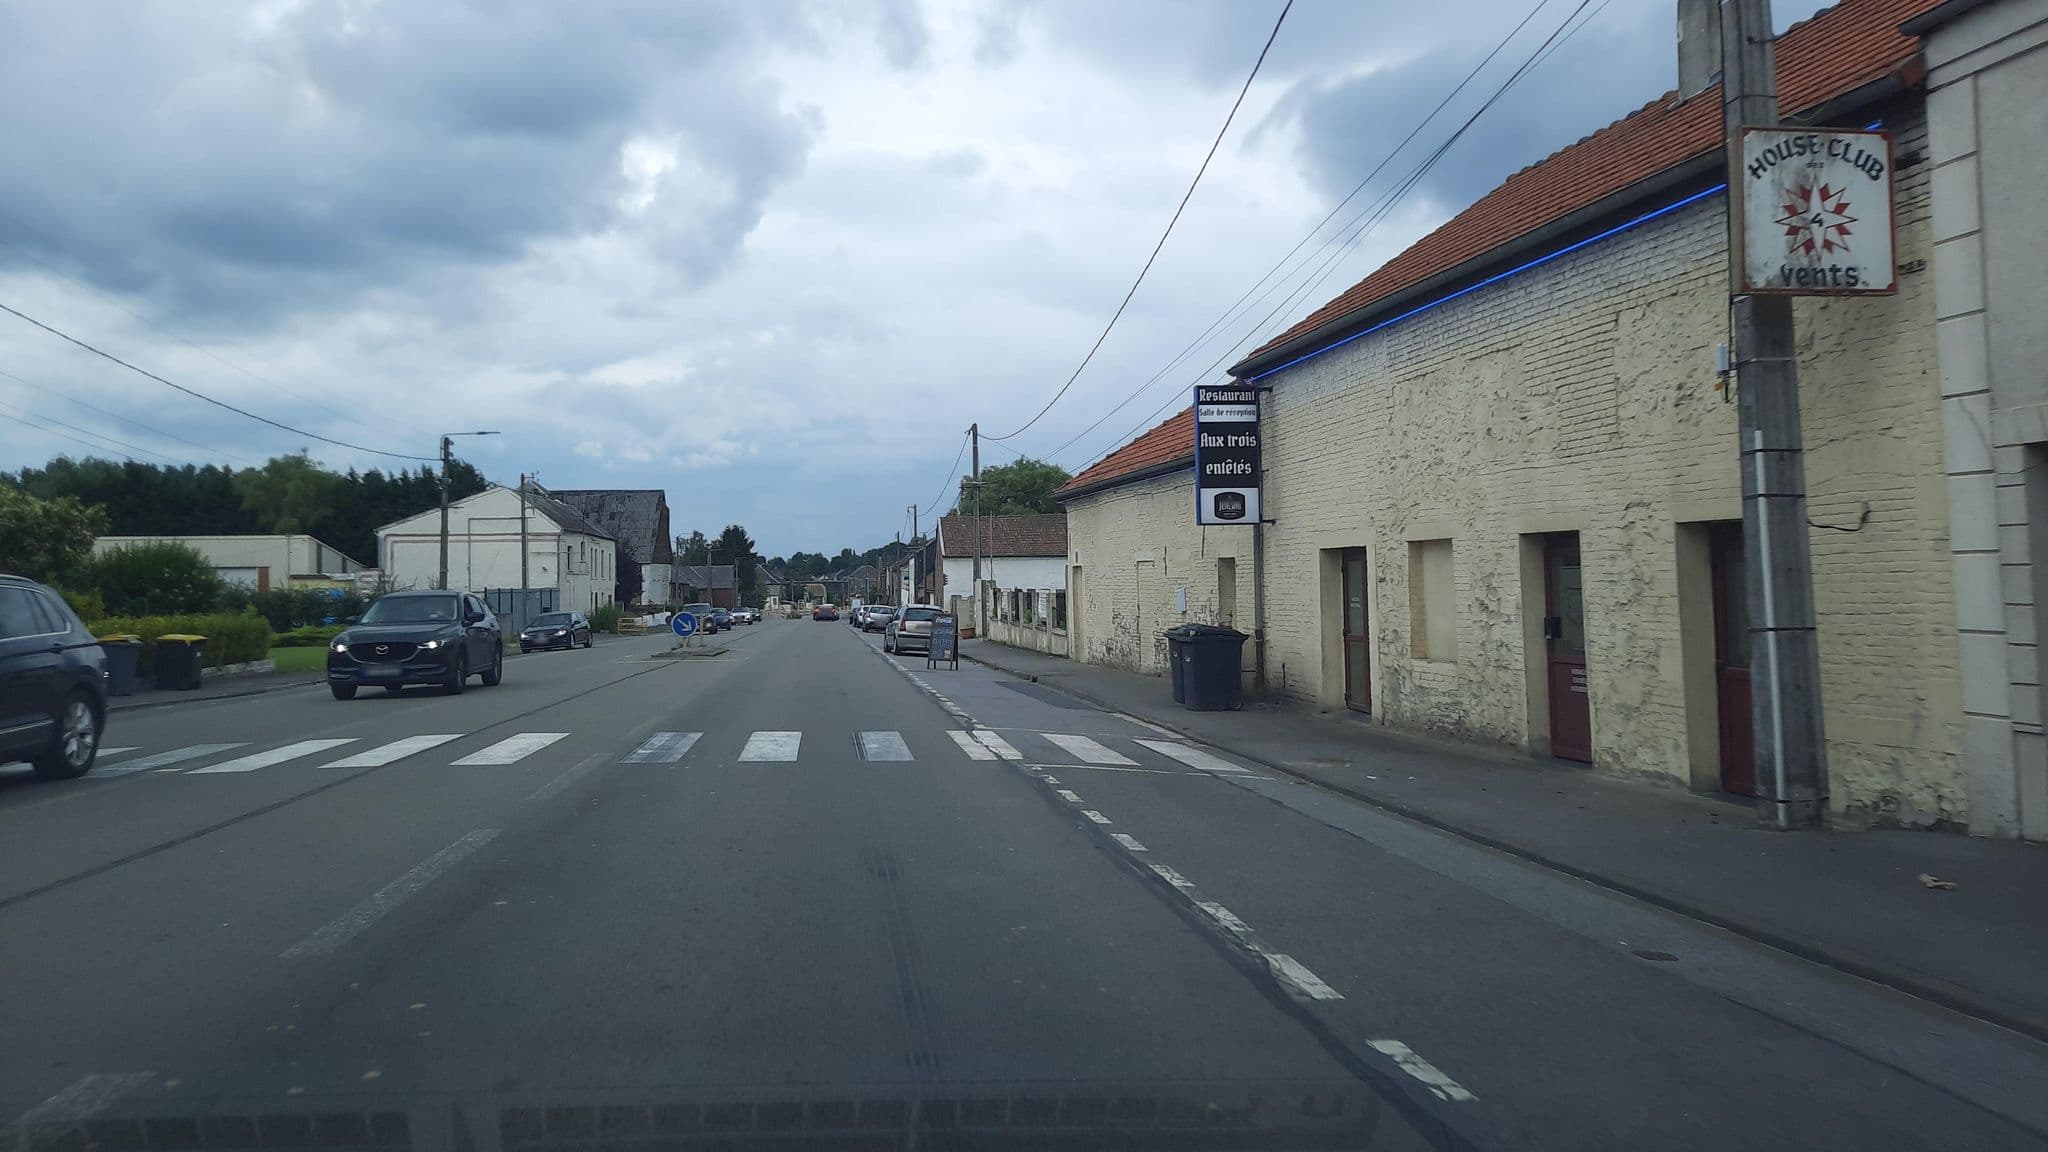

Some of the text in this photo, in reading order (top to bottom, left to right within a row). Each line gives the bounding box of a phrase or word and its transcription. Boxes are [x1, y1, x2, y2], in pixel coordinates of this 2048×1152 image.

[1748, 134, 1884, 182] HOUSE CLUB
[1811, 213, 1823, 227] 4
[1199, 388, 1255, 402] Restaurant
[1199, 408, 1256, 418] Salle de réception
[1200, 431, 1257, 448] Aux trois
[1206, 458, 1252, 475] entêtés
